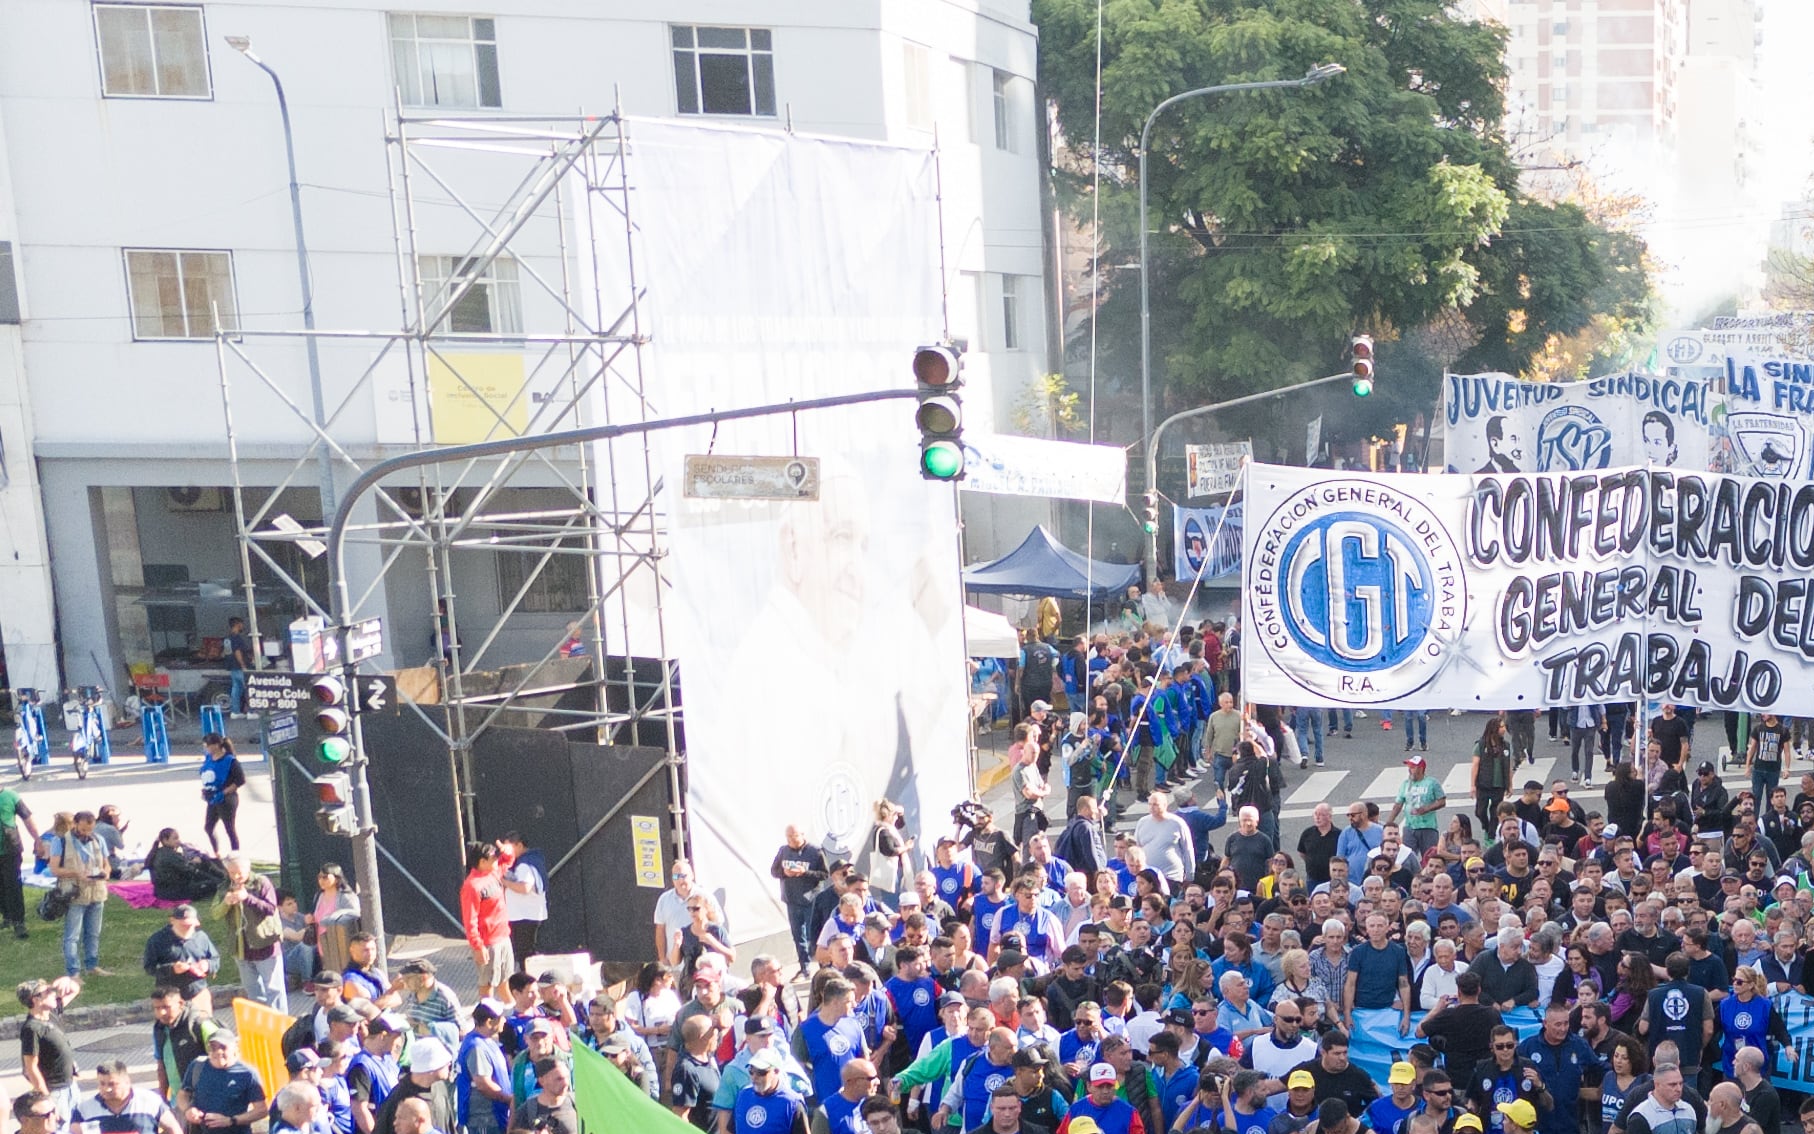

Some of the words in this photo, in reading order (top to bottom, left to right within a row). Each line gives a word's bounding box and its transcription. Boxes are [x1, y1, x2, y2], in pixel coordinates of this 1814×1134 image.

[1727, 357, 1761, 401] LA
[1323, 486, 1412, 523] GENERAL
[1416, 519, 1443, 558] DEL
[1501, 564, 1702, 653] GENERAL
[248, 675, 292, 687] Avenida
[248, 688, 281, 699] Paseo
[1542, 633, 1783, 708] TRABAJO
